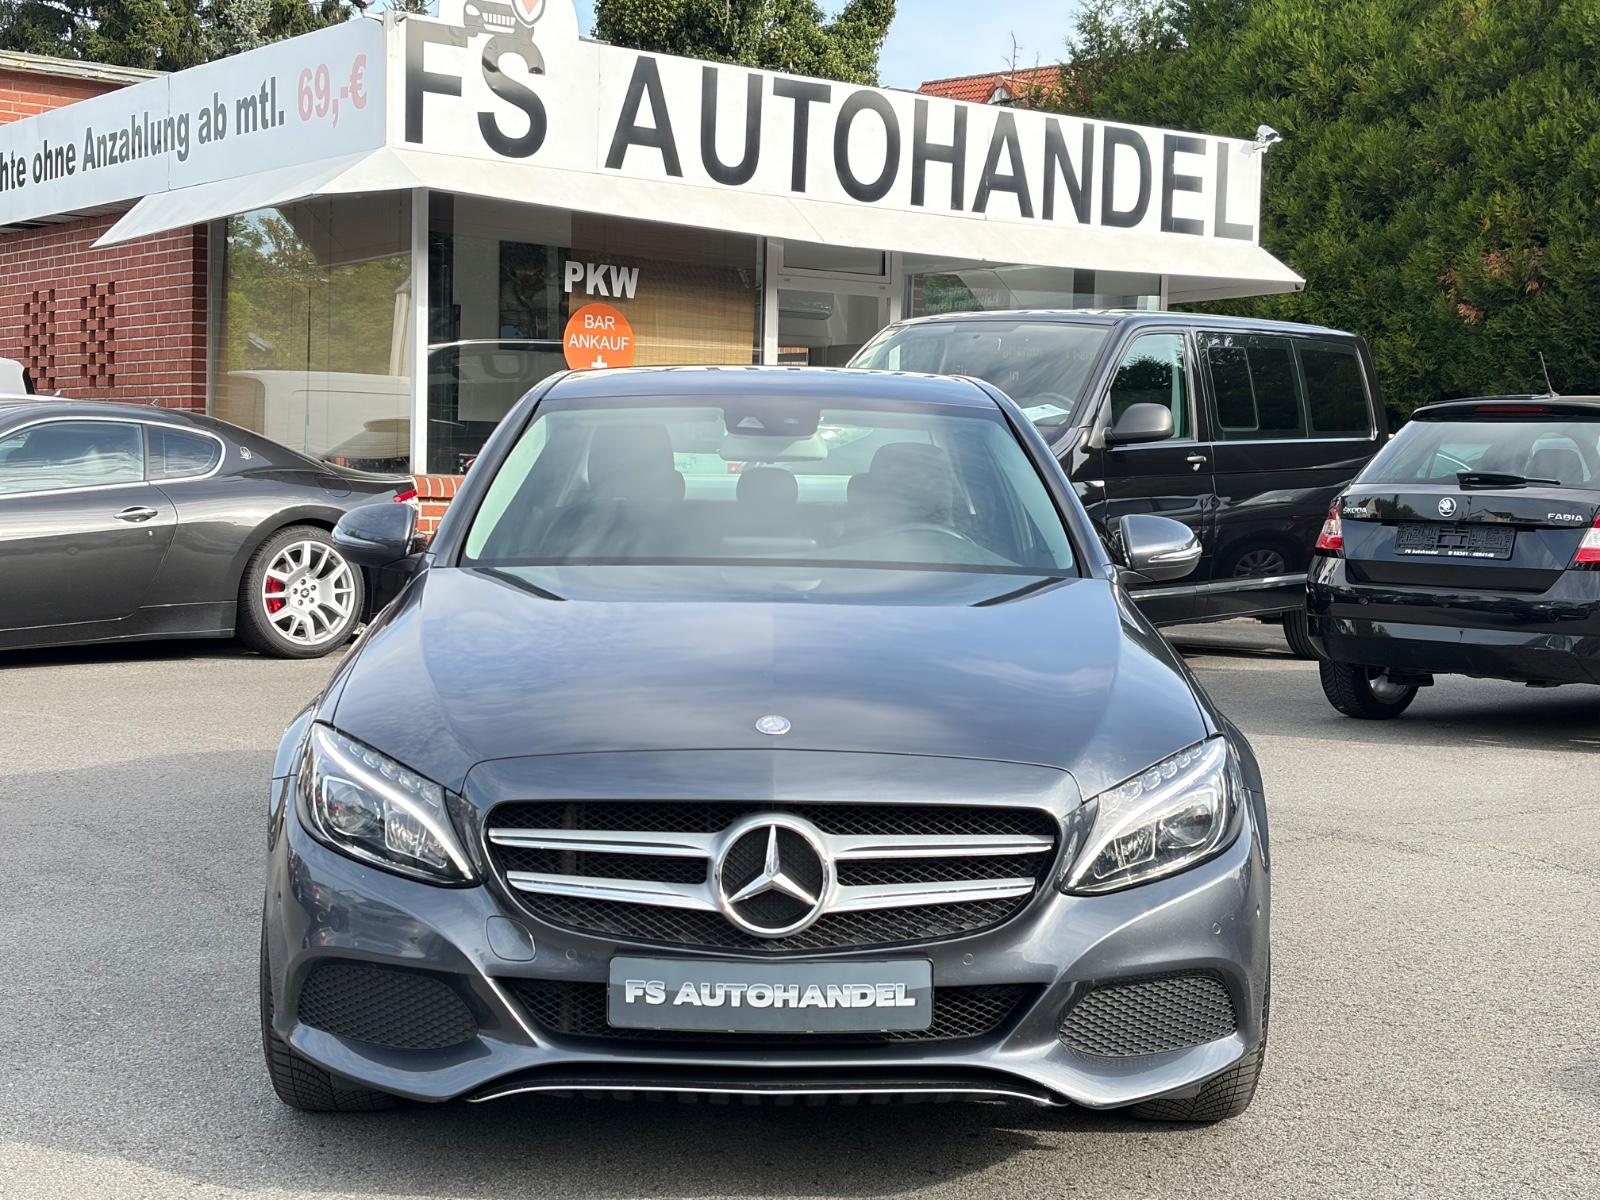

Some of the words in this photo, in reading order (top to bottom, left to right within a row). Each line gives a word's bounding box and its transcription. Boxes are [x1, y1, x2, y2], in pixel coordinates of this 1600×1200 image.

[0, 150, 26, 192] hte
[33, 140, 76, 184] ohne
[82, 111, 189, 171] Anzahlung
[198, 92, 227, 144] ab
[236, 76, 285, 135] mtl.
[298, 54, 367, 128] 69,-€
[404, 19, 548, 158] FS
[604, 55, 1254, 241] AUTOHANDEL
[564, 260, 639, 299] PKW
[584, 314, 615, 330] BAR
[568, 333, 629, 350] ANKAUF
[1548, 513, 1583, 521] FABIA
[625, 980, 666, 1004] FS
[673, 983, 916, 1008] AUTOHANDEL
